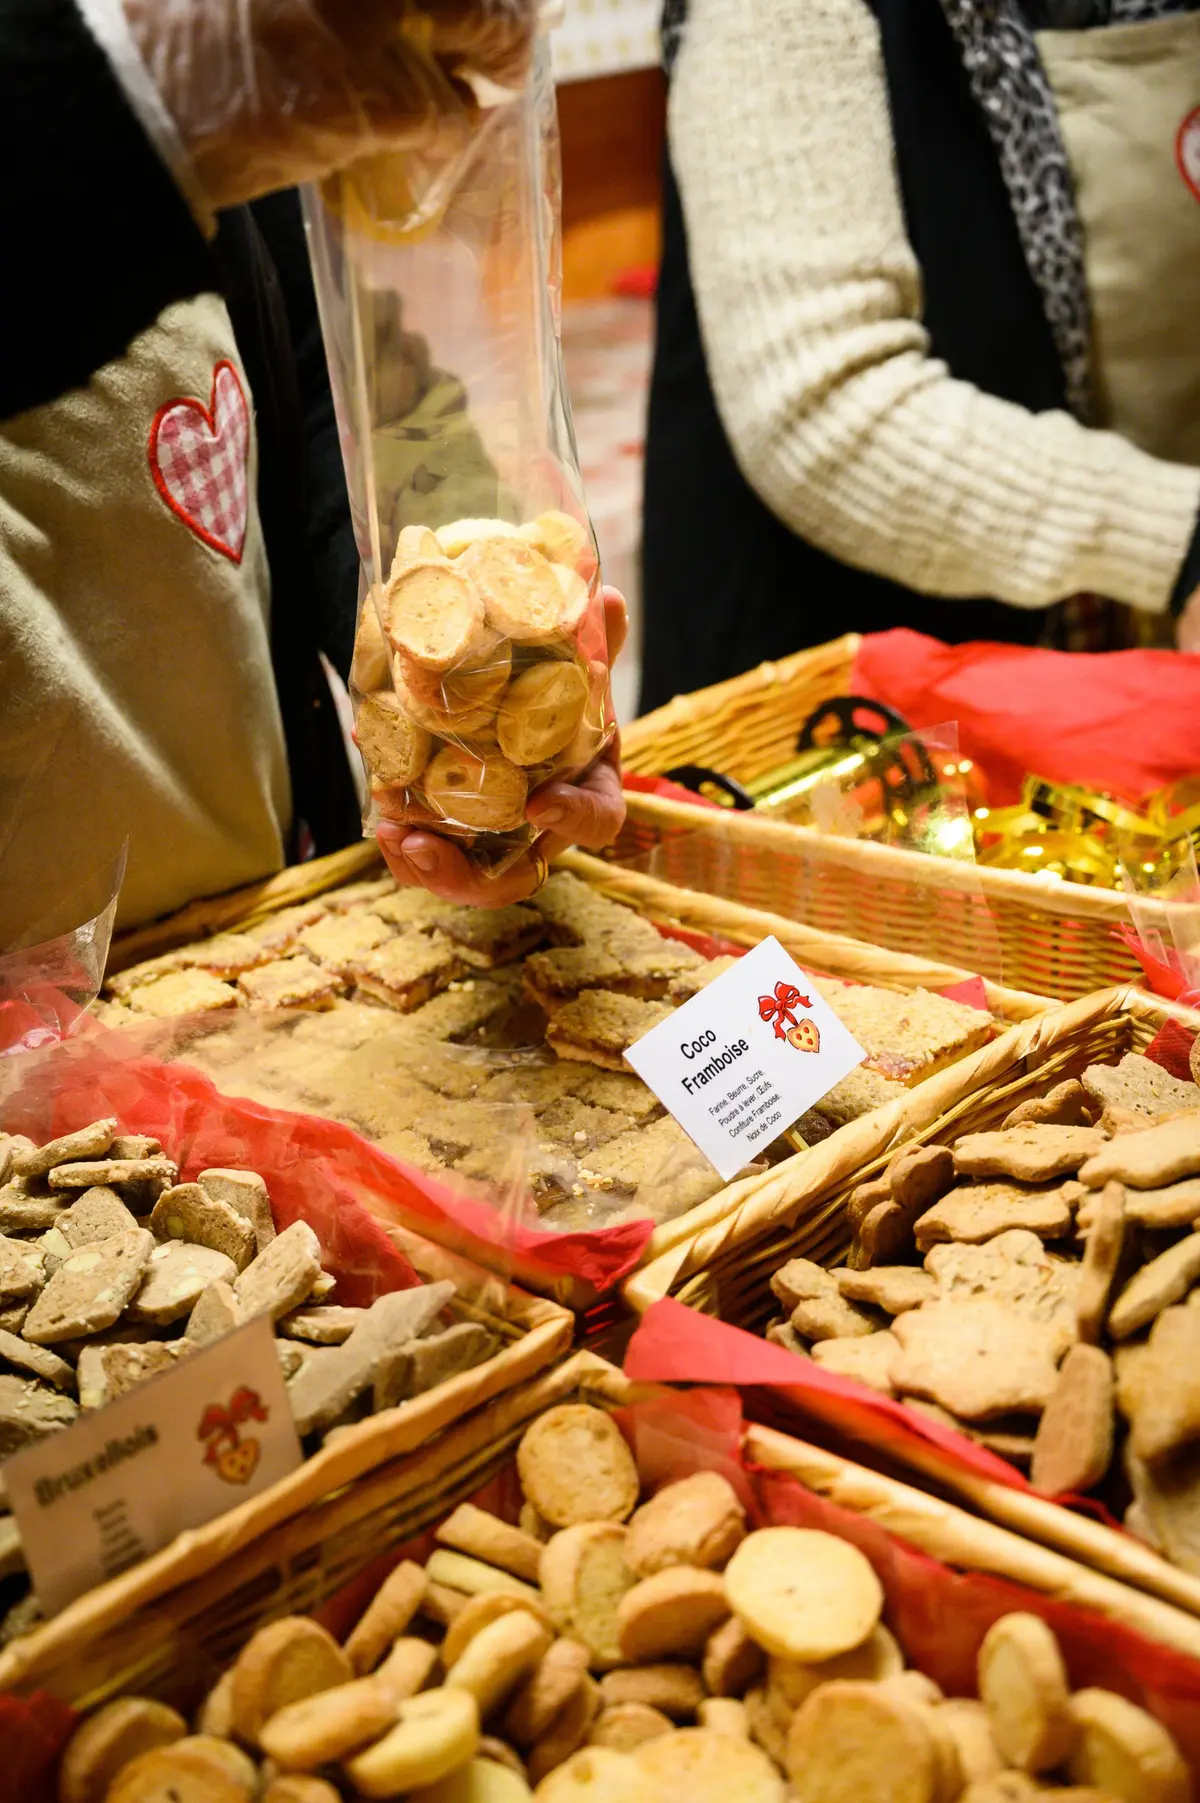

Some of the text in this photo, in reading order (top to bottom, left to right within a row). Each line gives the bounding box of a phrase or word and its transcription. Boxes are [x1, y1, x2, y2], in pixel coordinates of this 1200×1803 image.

[680, 1029, 717, 1060] Coco
[681, 1039, 749, 1095] Framboise
[708, 1069, 766, 1116] Farine, Beurre, Sucre,
[718, 1108, 740, 1127] Poudre
[742, 1093, 759, 1108] lever,
[729, 1093, 782, 1138] Confiture Framboise,
[746, 1111, 782, 1142] Noix de Coco
